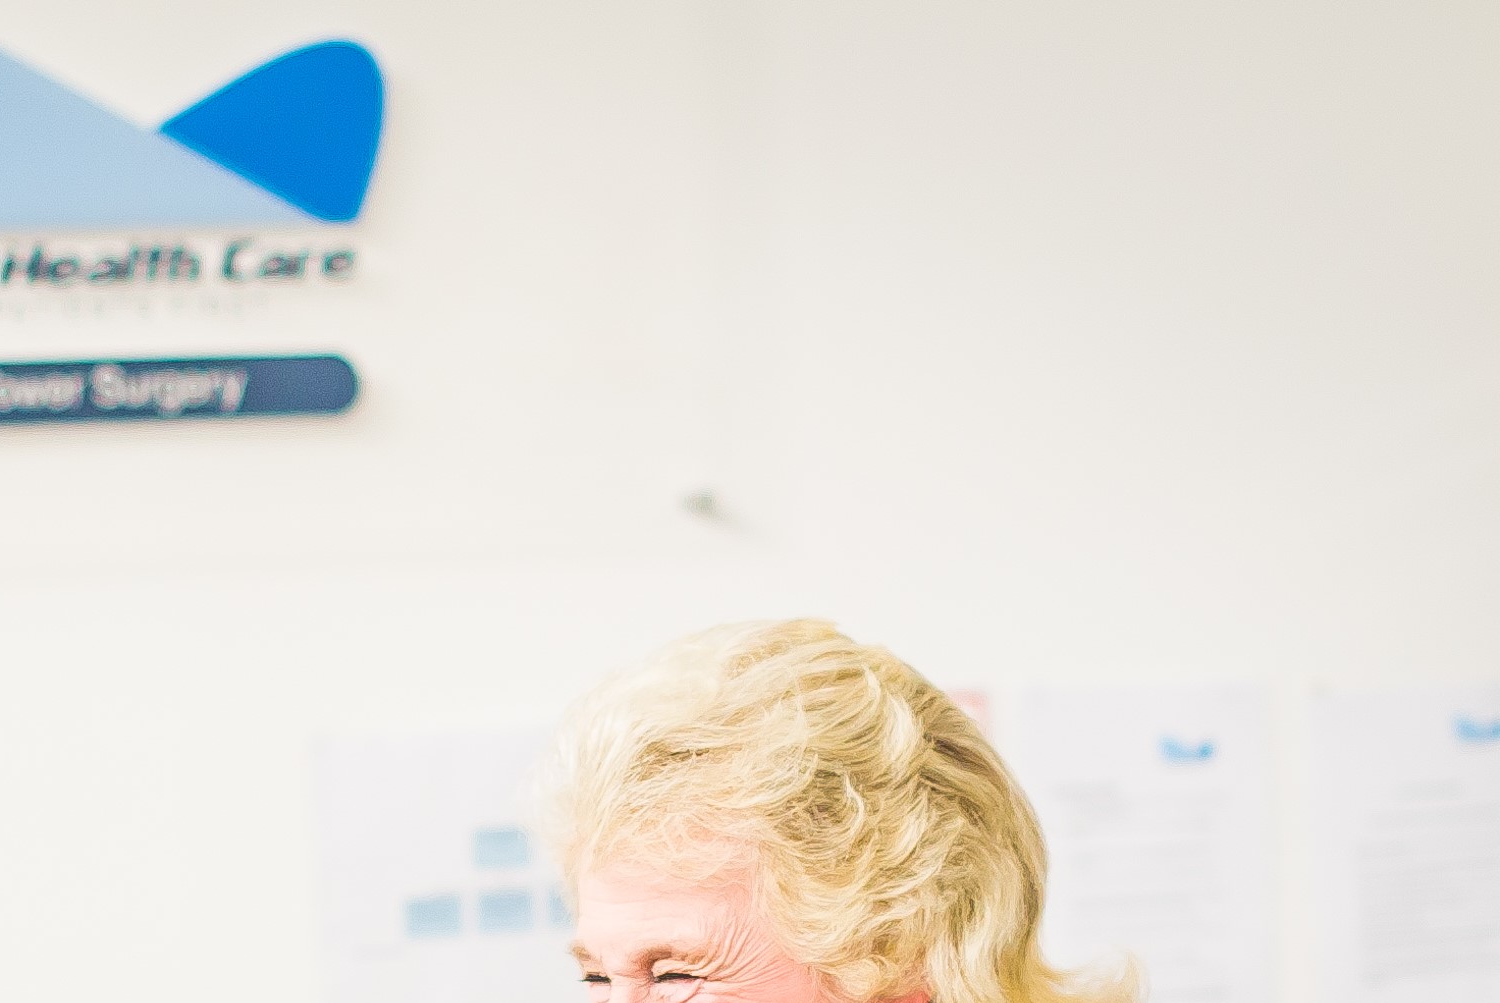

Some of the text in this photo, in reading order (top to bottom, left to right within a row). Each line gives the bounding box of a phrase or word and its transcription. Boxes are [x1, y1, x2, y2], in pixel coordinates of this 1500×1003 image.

[1, 244, 200, 284] Health
[222, 239, 355, 279] Care
[90, 361, 249, 415] Surgery
